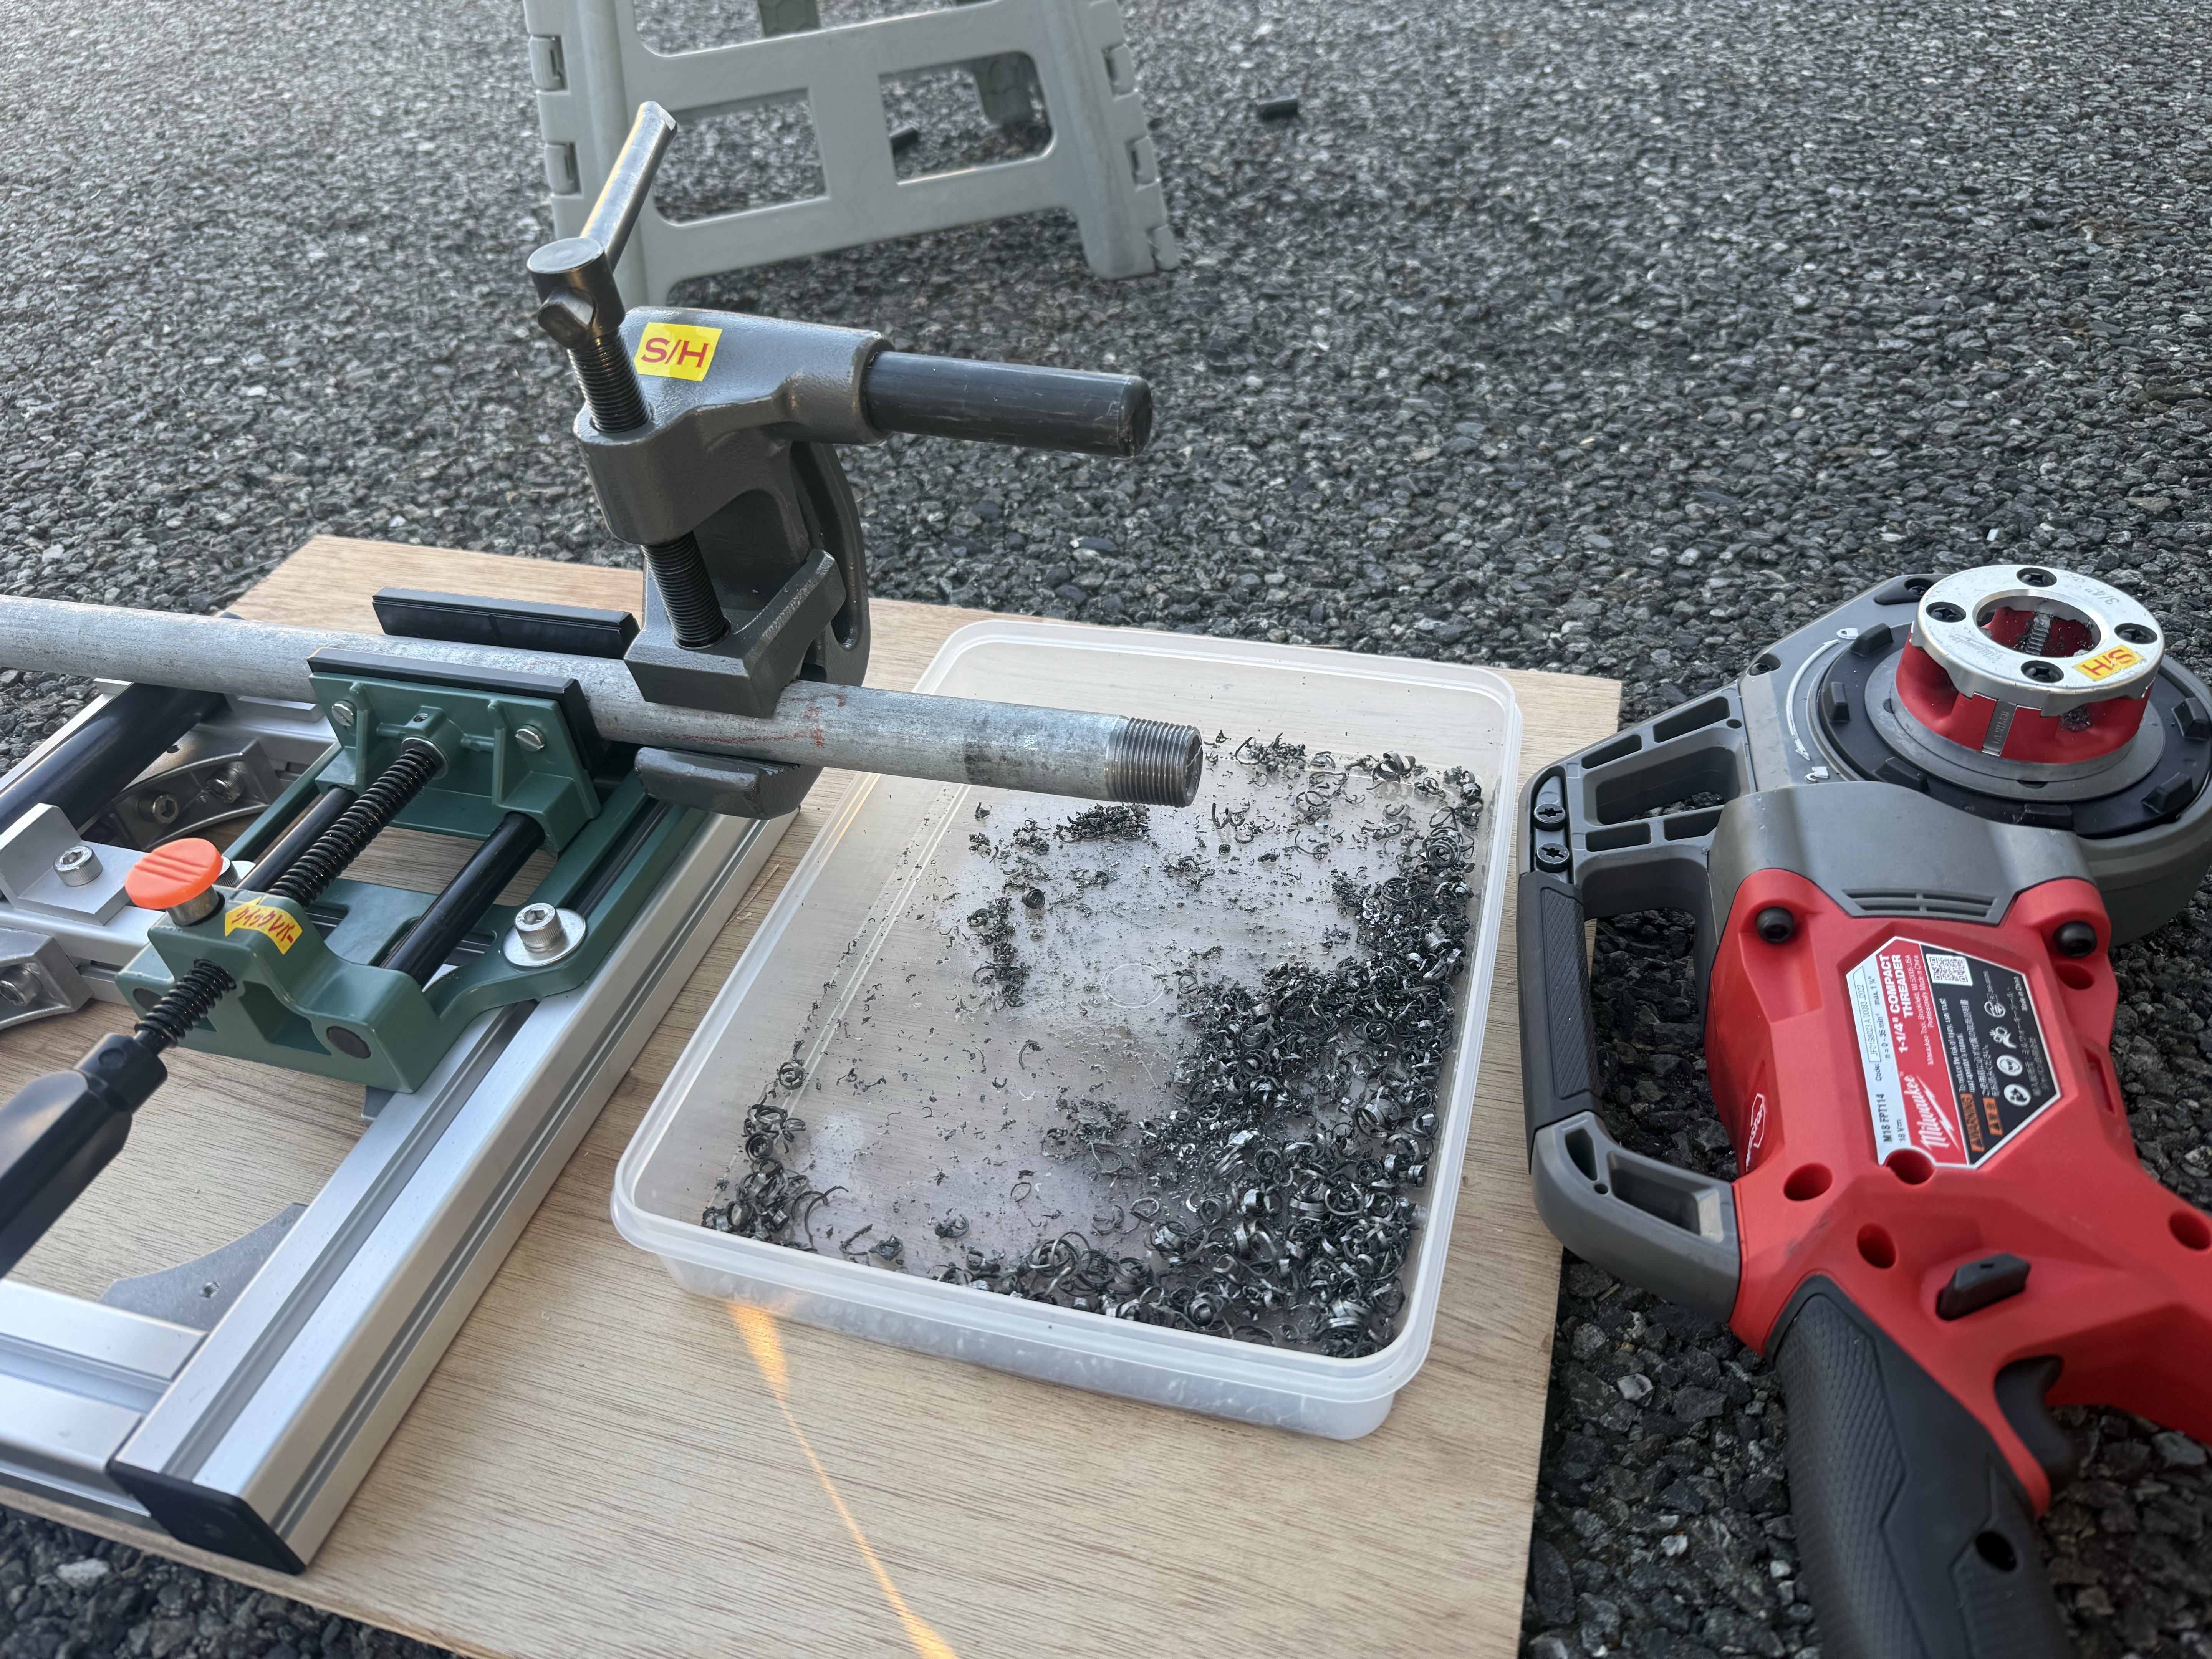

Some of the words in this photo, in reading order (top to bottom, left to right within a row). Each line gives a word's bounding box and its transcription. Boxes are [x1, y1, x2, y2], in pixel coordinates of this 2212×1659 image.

[641, 338, 710, 368] S/H
[1912, 955, 1921, 968] China
[1879, 955, 1900, 1013] COMPACT
[1891, 955, 1913, 1018] THREADER
[1917, 977, 1926, 990] Made
[1939, 998, 1948, 1010] must
[1955, 1066, 1964, 1083] reduce
[1876, 1094, 1888, 1122] FPT114
[1904, 1075, 1949, 1151] Milwaukee
[1962, 1097, 1980, 1139] WARNING
